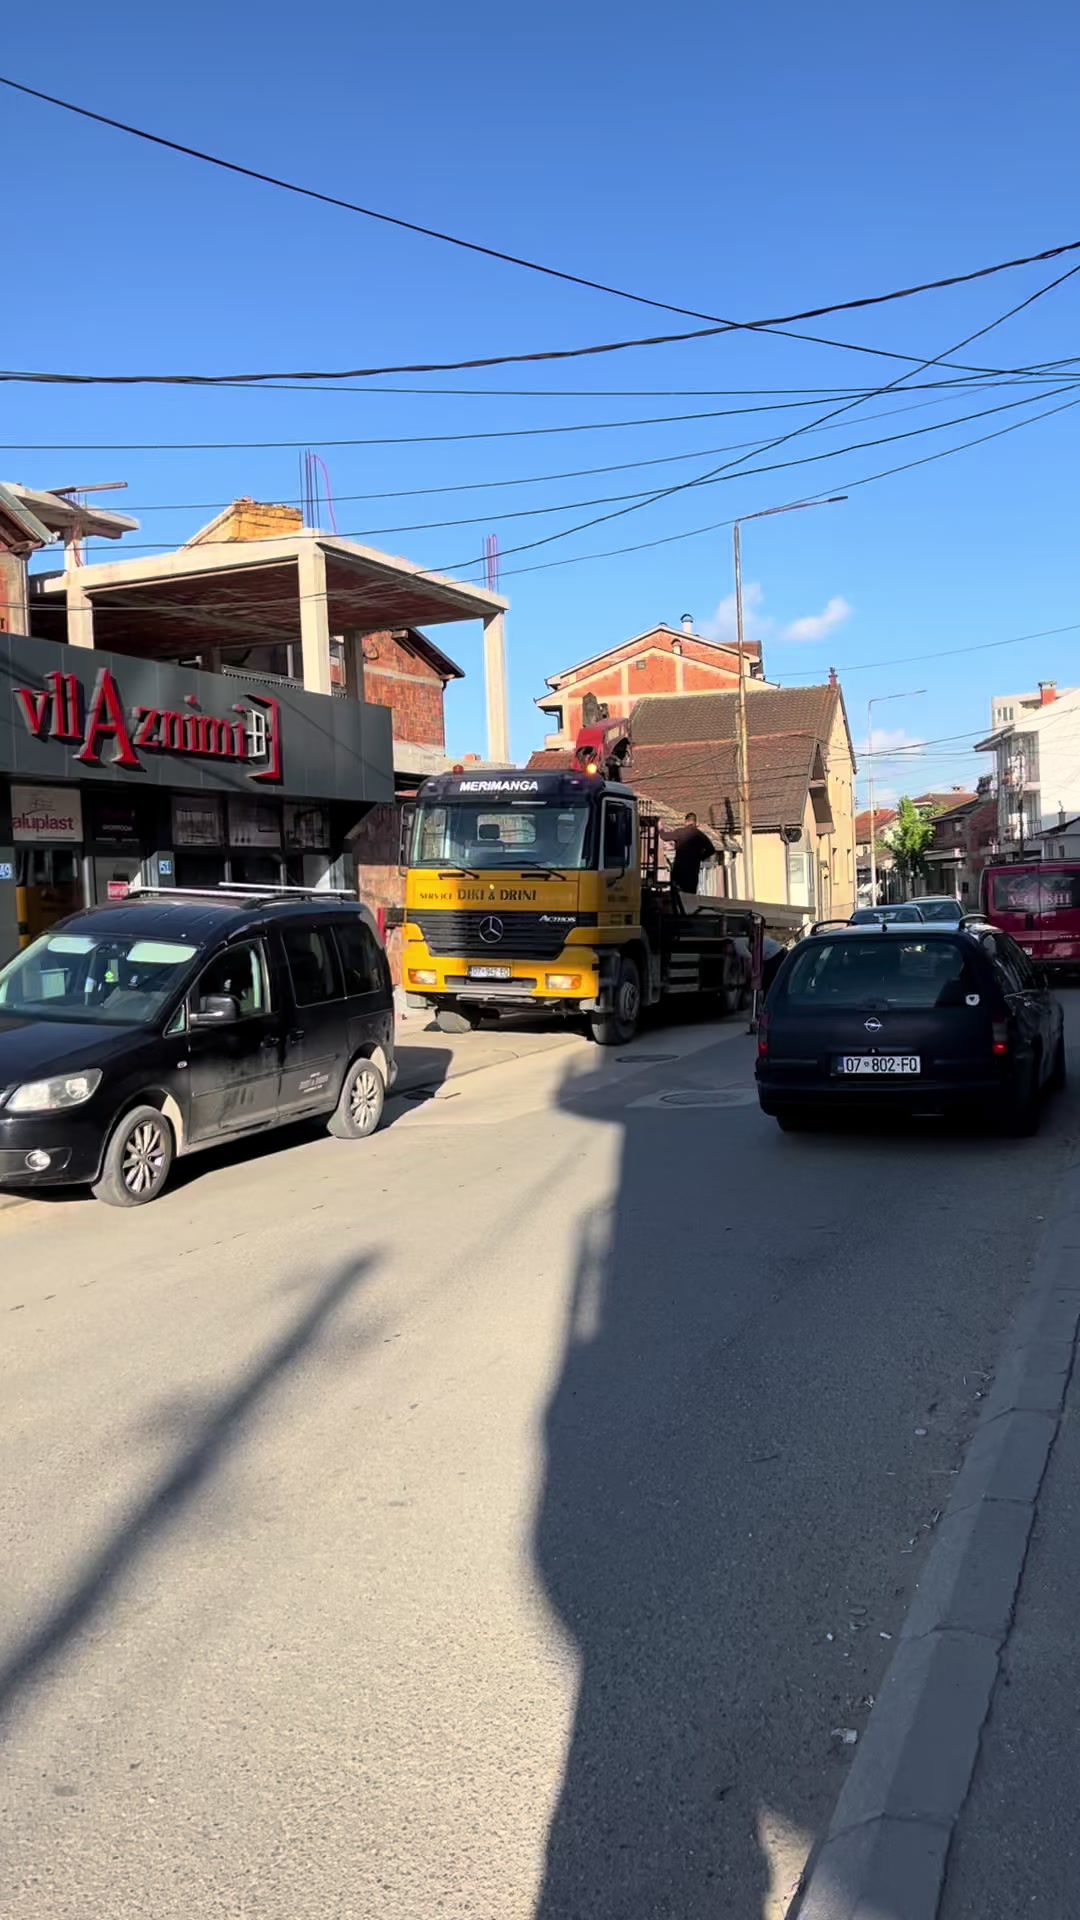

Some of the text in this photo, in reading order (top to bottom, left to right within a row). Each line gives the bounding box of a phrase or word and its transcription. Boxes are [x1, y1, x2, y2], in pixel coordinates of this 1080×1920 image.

[459, 780, 539, 792] MERIMANGA
[12, 812, 75, 833] aluplast
[457, 888, 485, 901] DIKI
[500, 889, 537, 901] DRINI
[846, 1057, 861, 1072] 07
